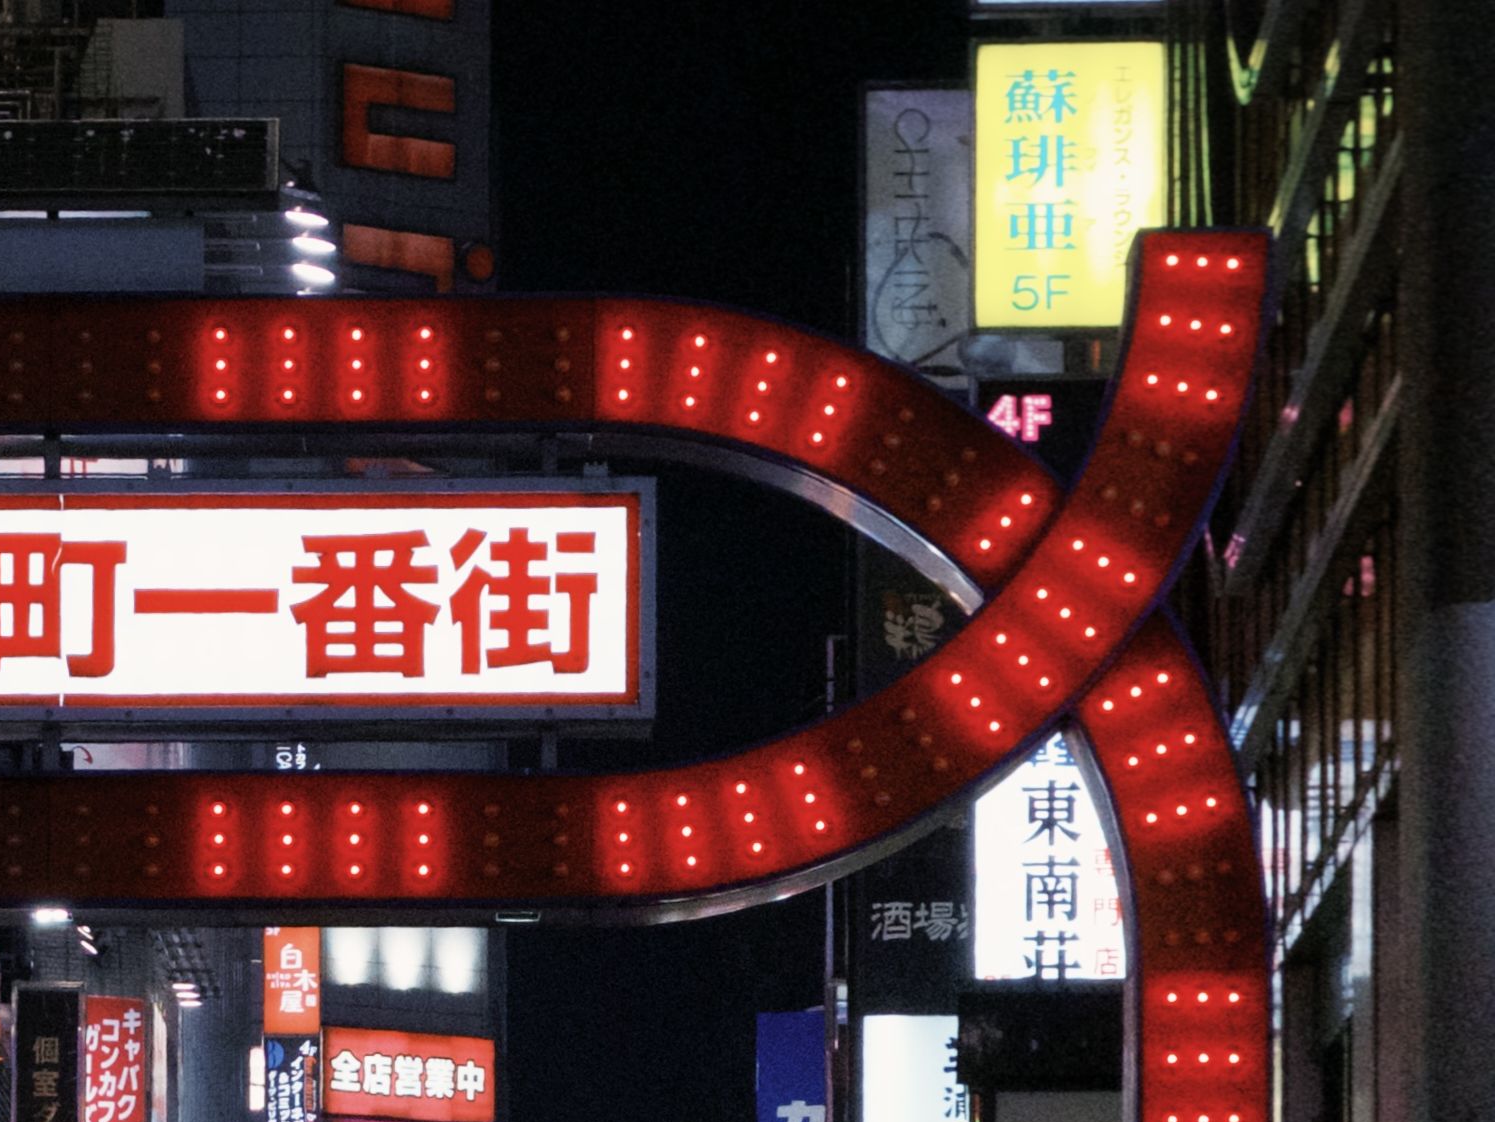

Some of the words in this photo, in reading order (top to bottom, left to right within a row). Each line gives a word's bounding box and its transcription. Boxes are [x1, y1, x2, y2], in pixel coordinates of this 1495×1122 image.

[1011, 275, 1071, 311] 5F
[988, 395, 1052, 441] 4F
[330, 1049, 486, 1102] 全店営業中
